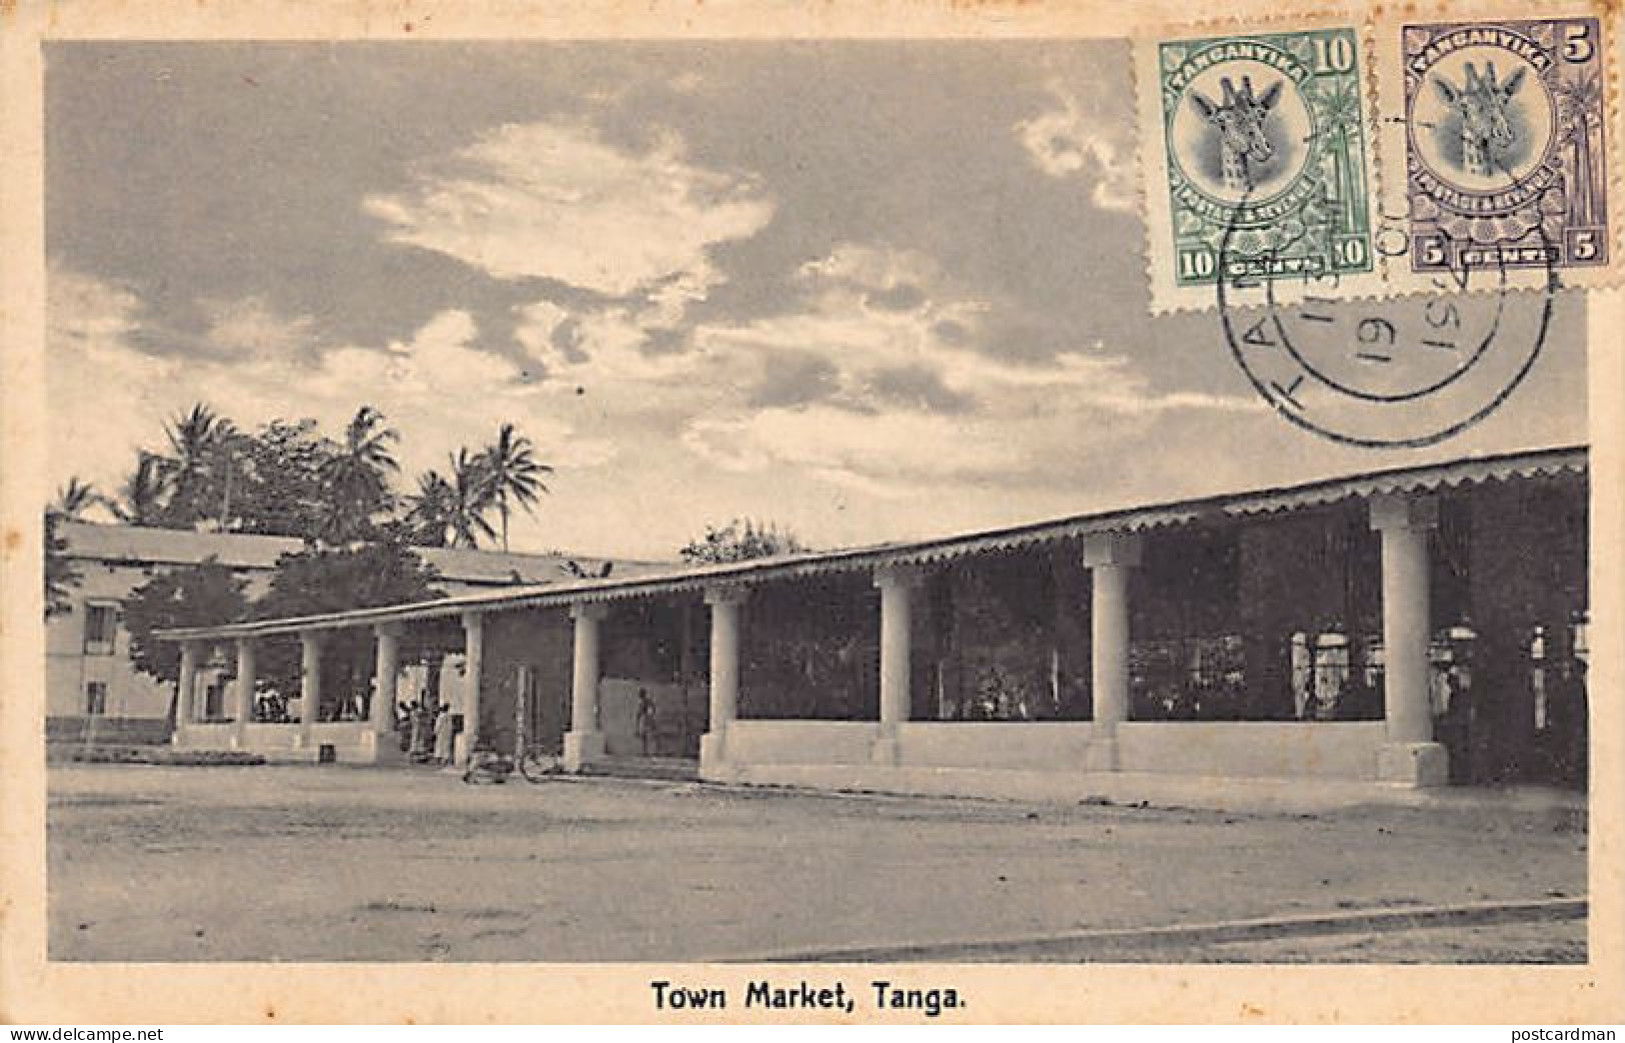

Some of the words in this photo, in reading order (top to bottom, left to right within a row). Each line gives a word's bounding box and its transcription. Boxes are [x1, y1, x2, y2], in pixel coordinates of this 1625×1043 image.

[1315, 36, 1353, 71] 10
[1563, 25, 1594, 63] 5
[1336, 239, 1364, 266] 10
[1423, 239, 1444, 265] 5
[1575, 233, 1597, 260] 5
[1181, 252, 1214, 276] 10
